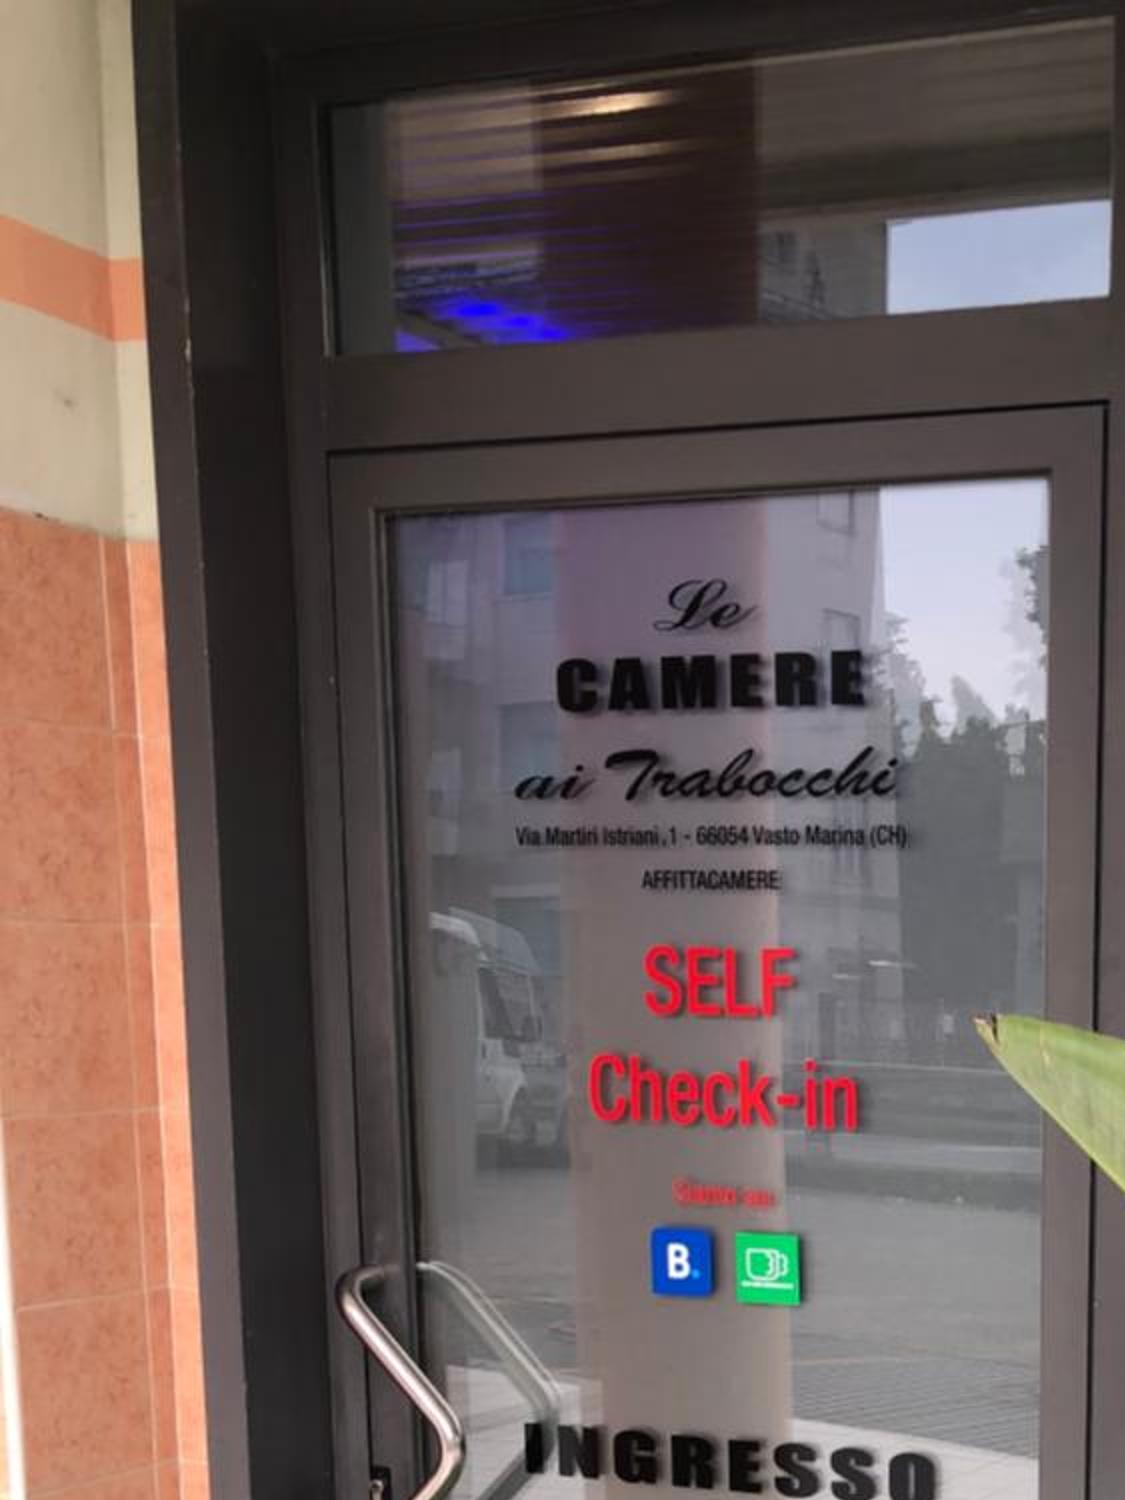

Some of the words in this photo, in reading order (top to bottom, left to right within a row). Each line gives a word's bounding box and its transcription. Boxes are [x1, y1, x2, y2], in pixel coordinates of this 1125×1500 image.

[653, 579, 755, 633] Le
[556, 650, 866, 714] CAMERE
[514, 765, 593, 800] ai
[605, 746, 898, 801] Trabocchi
[515, 826, 541, 847] Via
[696, 825, 749, 846] 66054
[752, 826, 800, 846] Vasto
[805, 825, 865, 846] Marina
[869, 824, 908, 848] (CH)
[641, 869, 781, 891] AFFITTACAMERE
[643, 945, 797, 1017] SELF
[587, 1054, 860, 1130] Check-in
